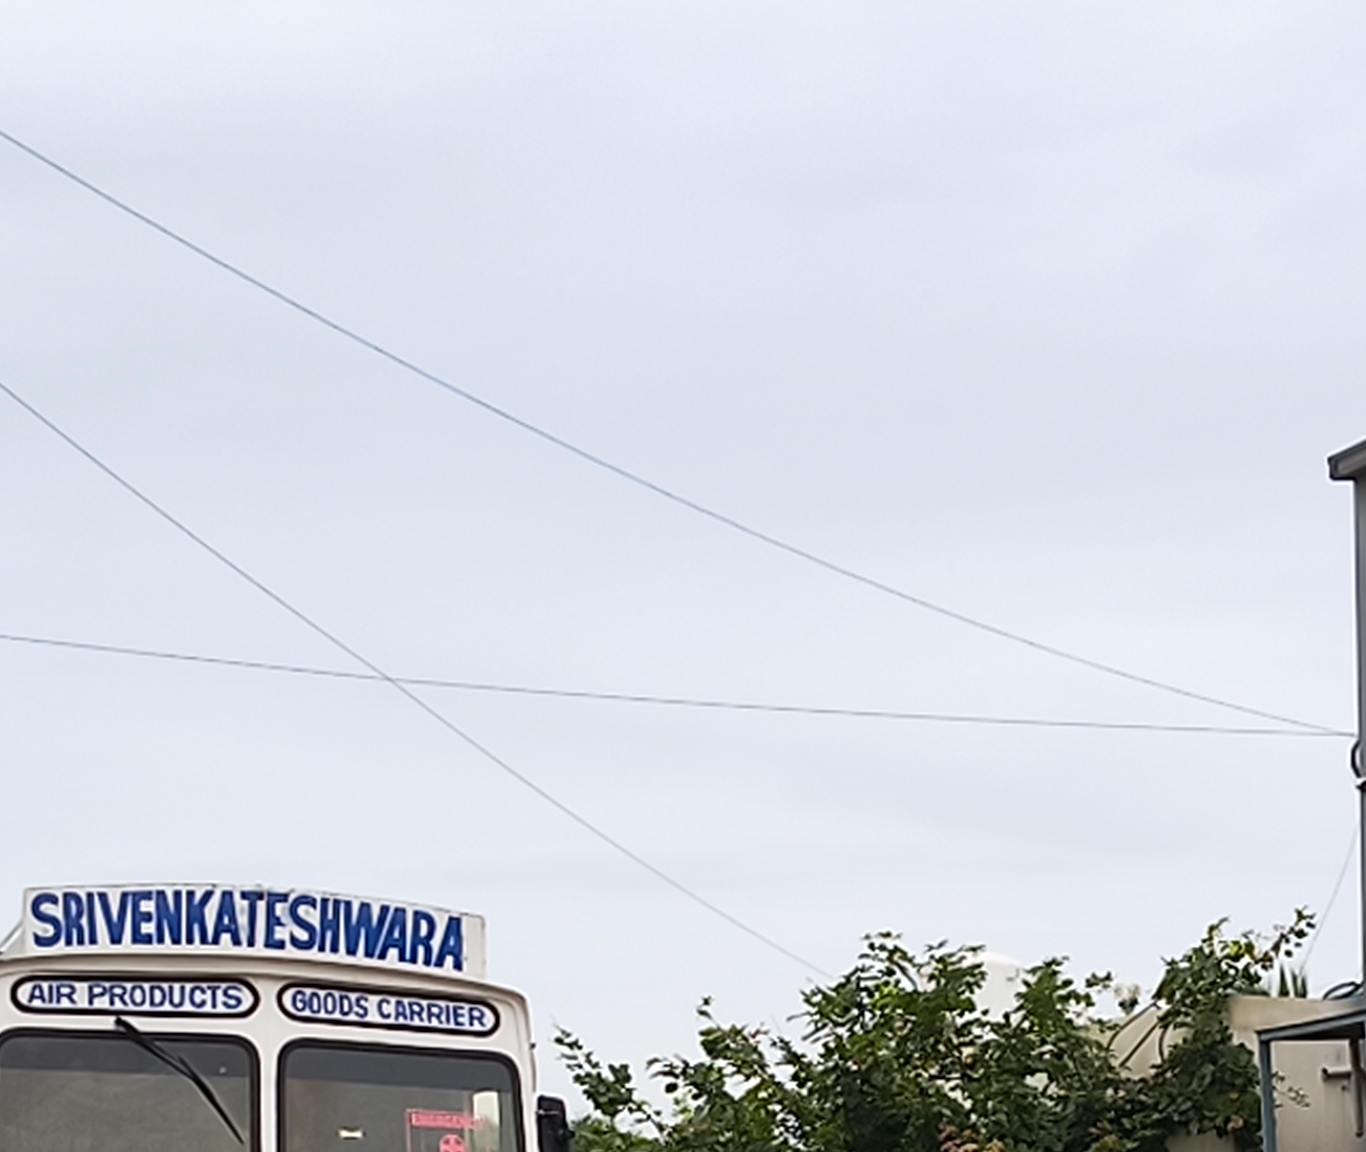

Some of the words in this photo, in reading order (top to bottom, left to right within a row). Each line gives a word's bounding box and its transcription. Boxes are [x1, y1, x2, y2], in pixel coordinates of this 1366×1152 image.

[30, 889, 464, 972] SRIVENKATESHWARA
[28, 983, 77, 1005] AIR
[88, 983, 243, 1010] PRODUCTS
[291, 990, 369, 1019] GOODS
[378, 1000, 488, 1028] CARRIER
